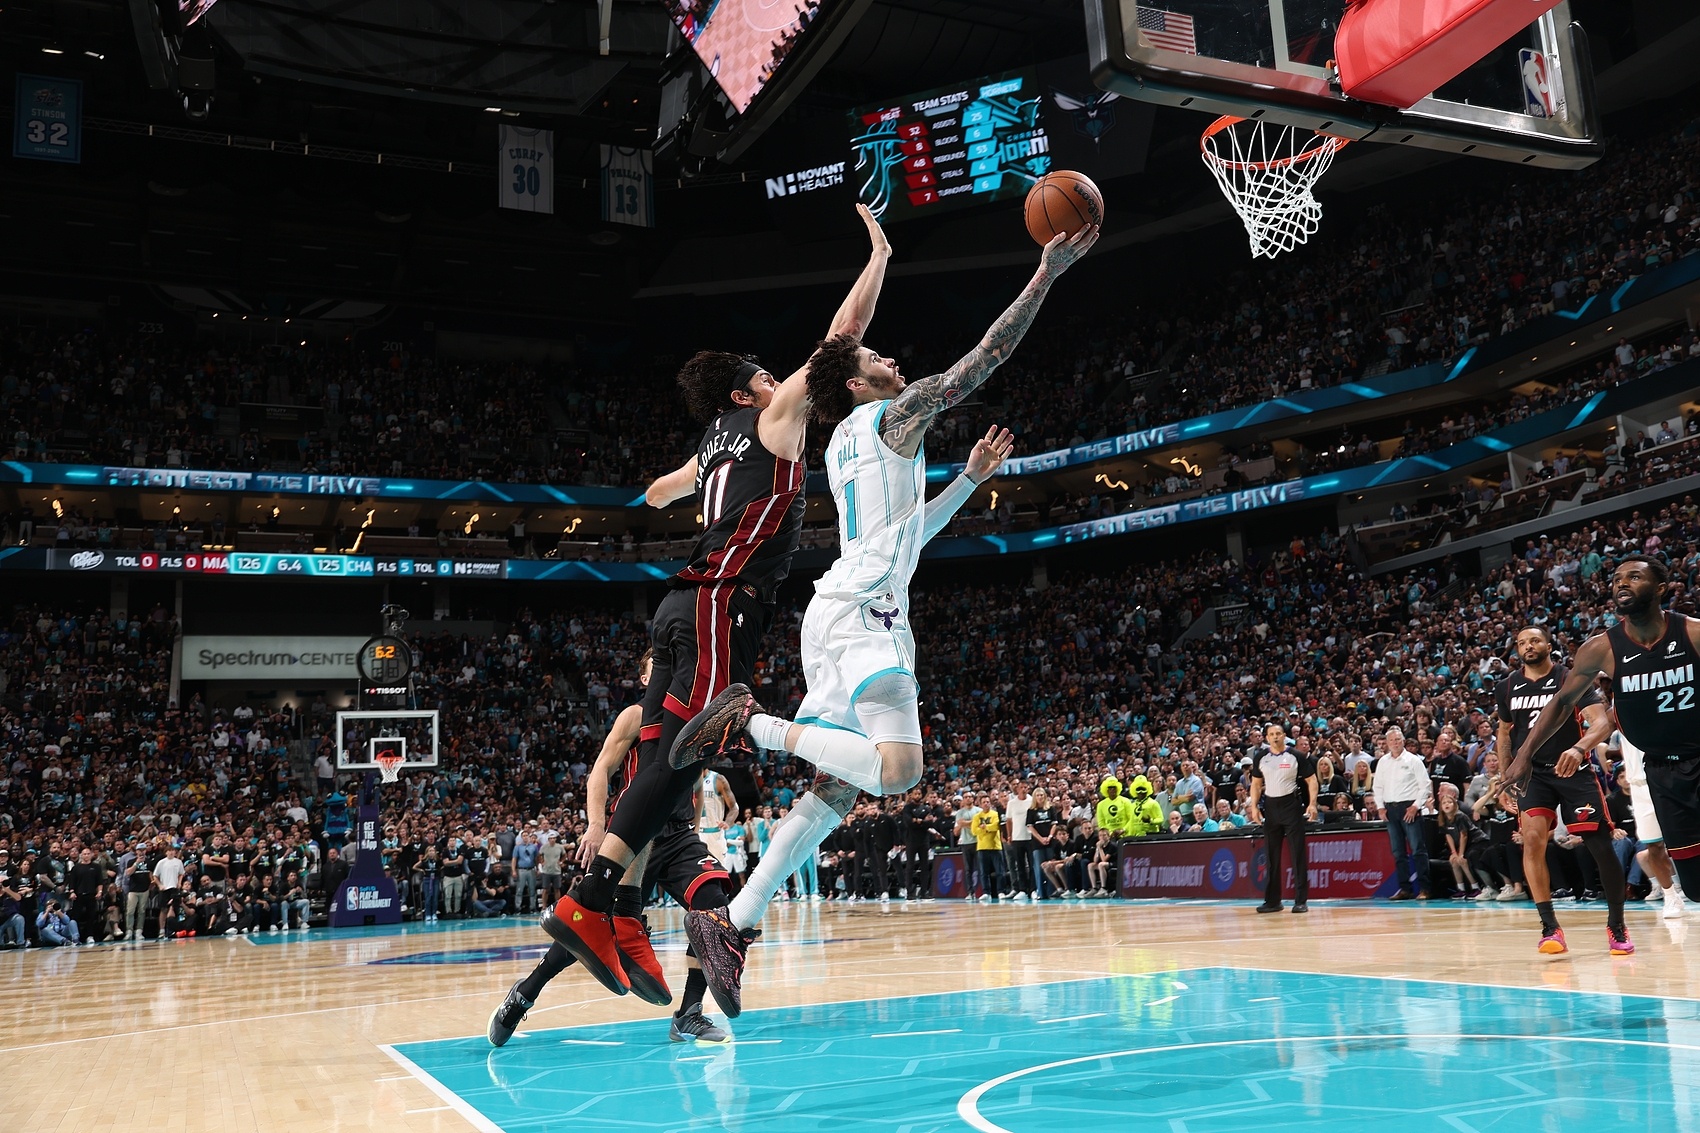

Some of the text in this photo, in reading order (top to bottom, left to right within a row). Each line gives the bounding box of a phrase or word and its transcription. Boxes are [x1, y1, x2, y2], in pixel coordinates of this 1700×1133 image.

[912, 91, 969, 112] TEAM STATS
[31, 108, 66, 120] STINSON
[880, 110, 901, 122] HEAT
[27, 119, 69, 146] 32
[908, 126, 921, 136] 32
[971, 112, 983, 122] 25
[915, 142, 924, 152] 8
[973, 129, 981, 138] 6
[509, 148, 544, 163] CURRY
[913, 157, 926, 168] 48
[513, 164, 541, 196] 30
[611, 169, 642, 183] PHILLS
[797, 162, 845, 181] NOVANT
[921, 174, 929, 183] 4
[978, 162, 986, 171] 4
[799, 173, 844, 192] HEALTH
[924, 193, 932, 202] 7
[982, 179, 989, 189] 6
[615, 184, 638, 215] 13
[727, 432, 752, 461] JR.
[1074, 440, 1112, 459] THE
[1115, 423, 1180, 454] HIVE
[838, 437, 859, 471] BALL
[103, 466, 381, 494] PROTECT THE HIVE
[703, 459, 734, 531] 11
[844, 478, 857, 541] 1
[1059, 479, 1304, 544] PROTECT THE HIVE
[115, 555, 153, 567] TOL 0
[160, 557, 197, 568] FLS 0
[203, 558, 230, 570] MIA
[237, 558, 261, 570] 126
[277, 559, 302, 572] 6.4
[317, 559, 341, 572] 125
[346, 560, 373, 573] CHA
[377, 561, 411, 573] FLS 5
[414, 562, 450, 573] TOL 0
[1220, 608, 1243, 617] UTILITY
[199, 649, 365, 669] Spectrum CENTE
[1621, 663, 1694, 693] MIAMI
[376, 687, 407, 695] TISSOT
[1656, 686, 1696, 713] 22
[1510, 694, 1555, 711] MIAM
[363, 821, 375, 831] GET
[364, 830, 375, 840] THE
[1308, 840, 1363, 863] TOMORROW
[1159, 865, 1205, 887] TOURNAMENT
[1319, 868, 1331, 888] ET
[1333, 870, 1349, 883] Only
[1359, 869, 1384, 883] prime
[359, 890, 379, 900] PLAY-IN
[359, 898, 392, 909] TOURNAMENT
